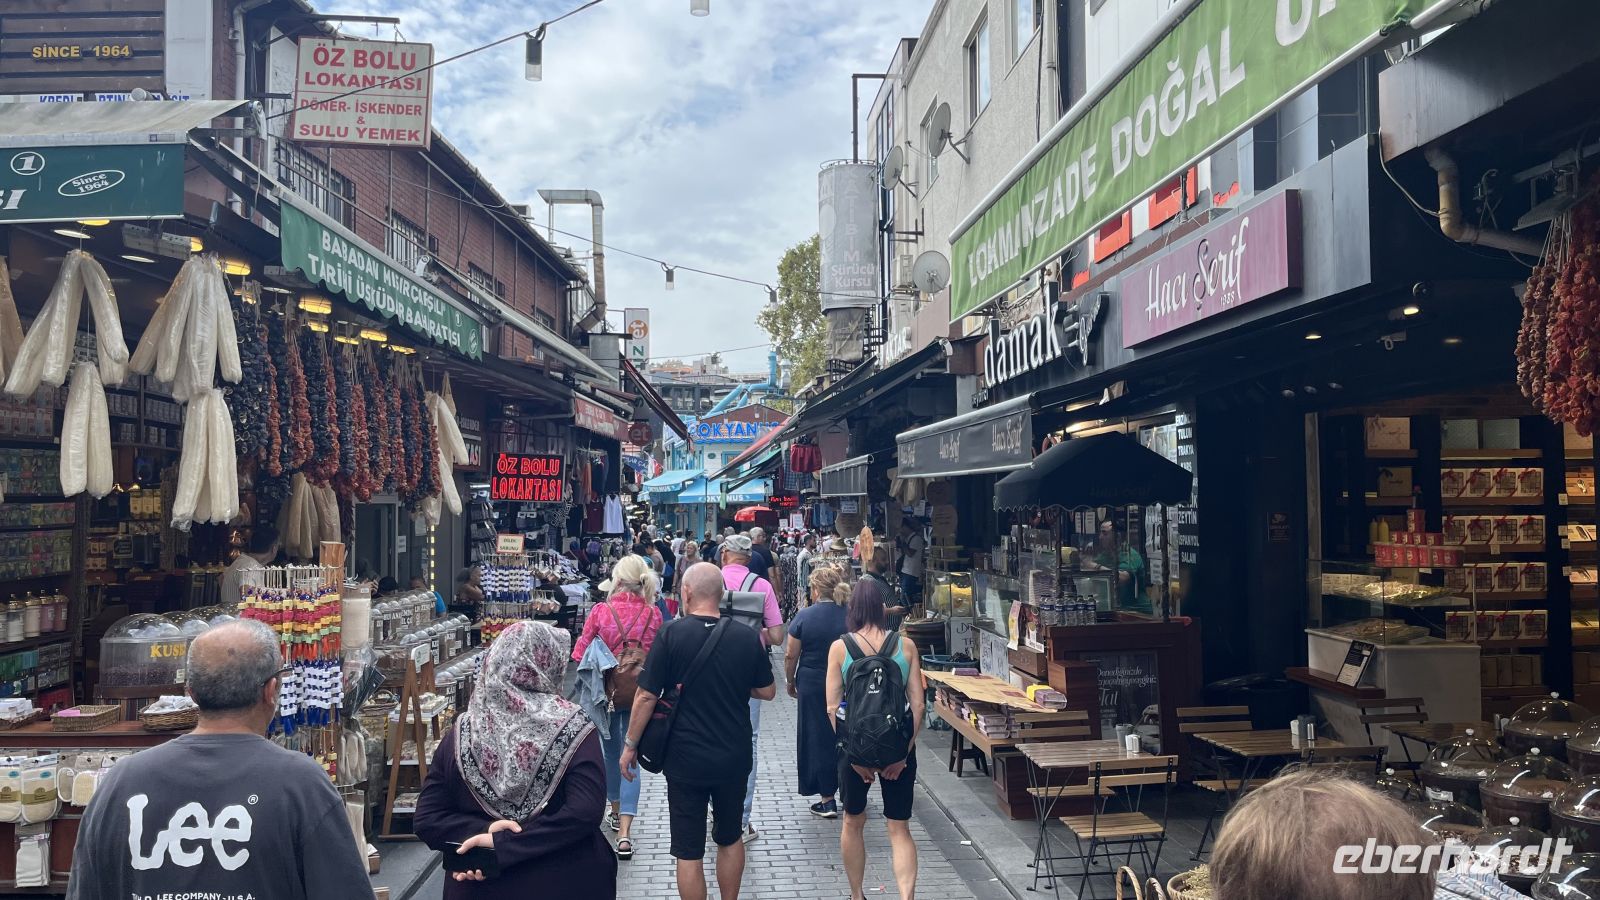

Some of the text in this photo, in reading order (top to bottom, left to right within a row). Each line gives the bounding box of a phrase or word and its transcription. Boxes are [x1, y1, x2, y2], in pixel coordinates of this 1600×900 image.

[32, 44, 130, 58] SİNCE 1964
[313, 43, 416, 71] ÖZ BOLU
[304, 71, 422, 91] LOKANTASI
[354, 99, 422, 116] İSKENDER
[1111, 27, 1246, 177] DOĞAL
[356, 116, 365, 125] &
[299, 124, 421, 142] SULU YEMEK
[17, 155, 37, 171] 1
[72, 172, 107, 188] Since
[77, 180, 110, 195] 1964
[322, 230, 380, 281] BABADAN
[984, 281, 1061, 388] damak
[497, 453, 518, 474] ÖZ
[520, 457, 560, 476] BOLU
[491, 476, 562, 501] LOKANTASI
[127, 794, 252, 871] Lee
